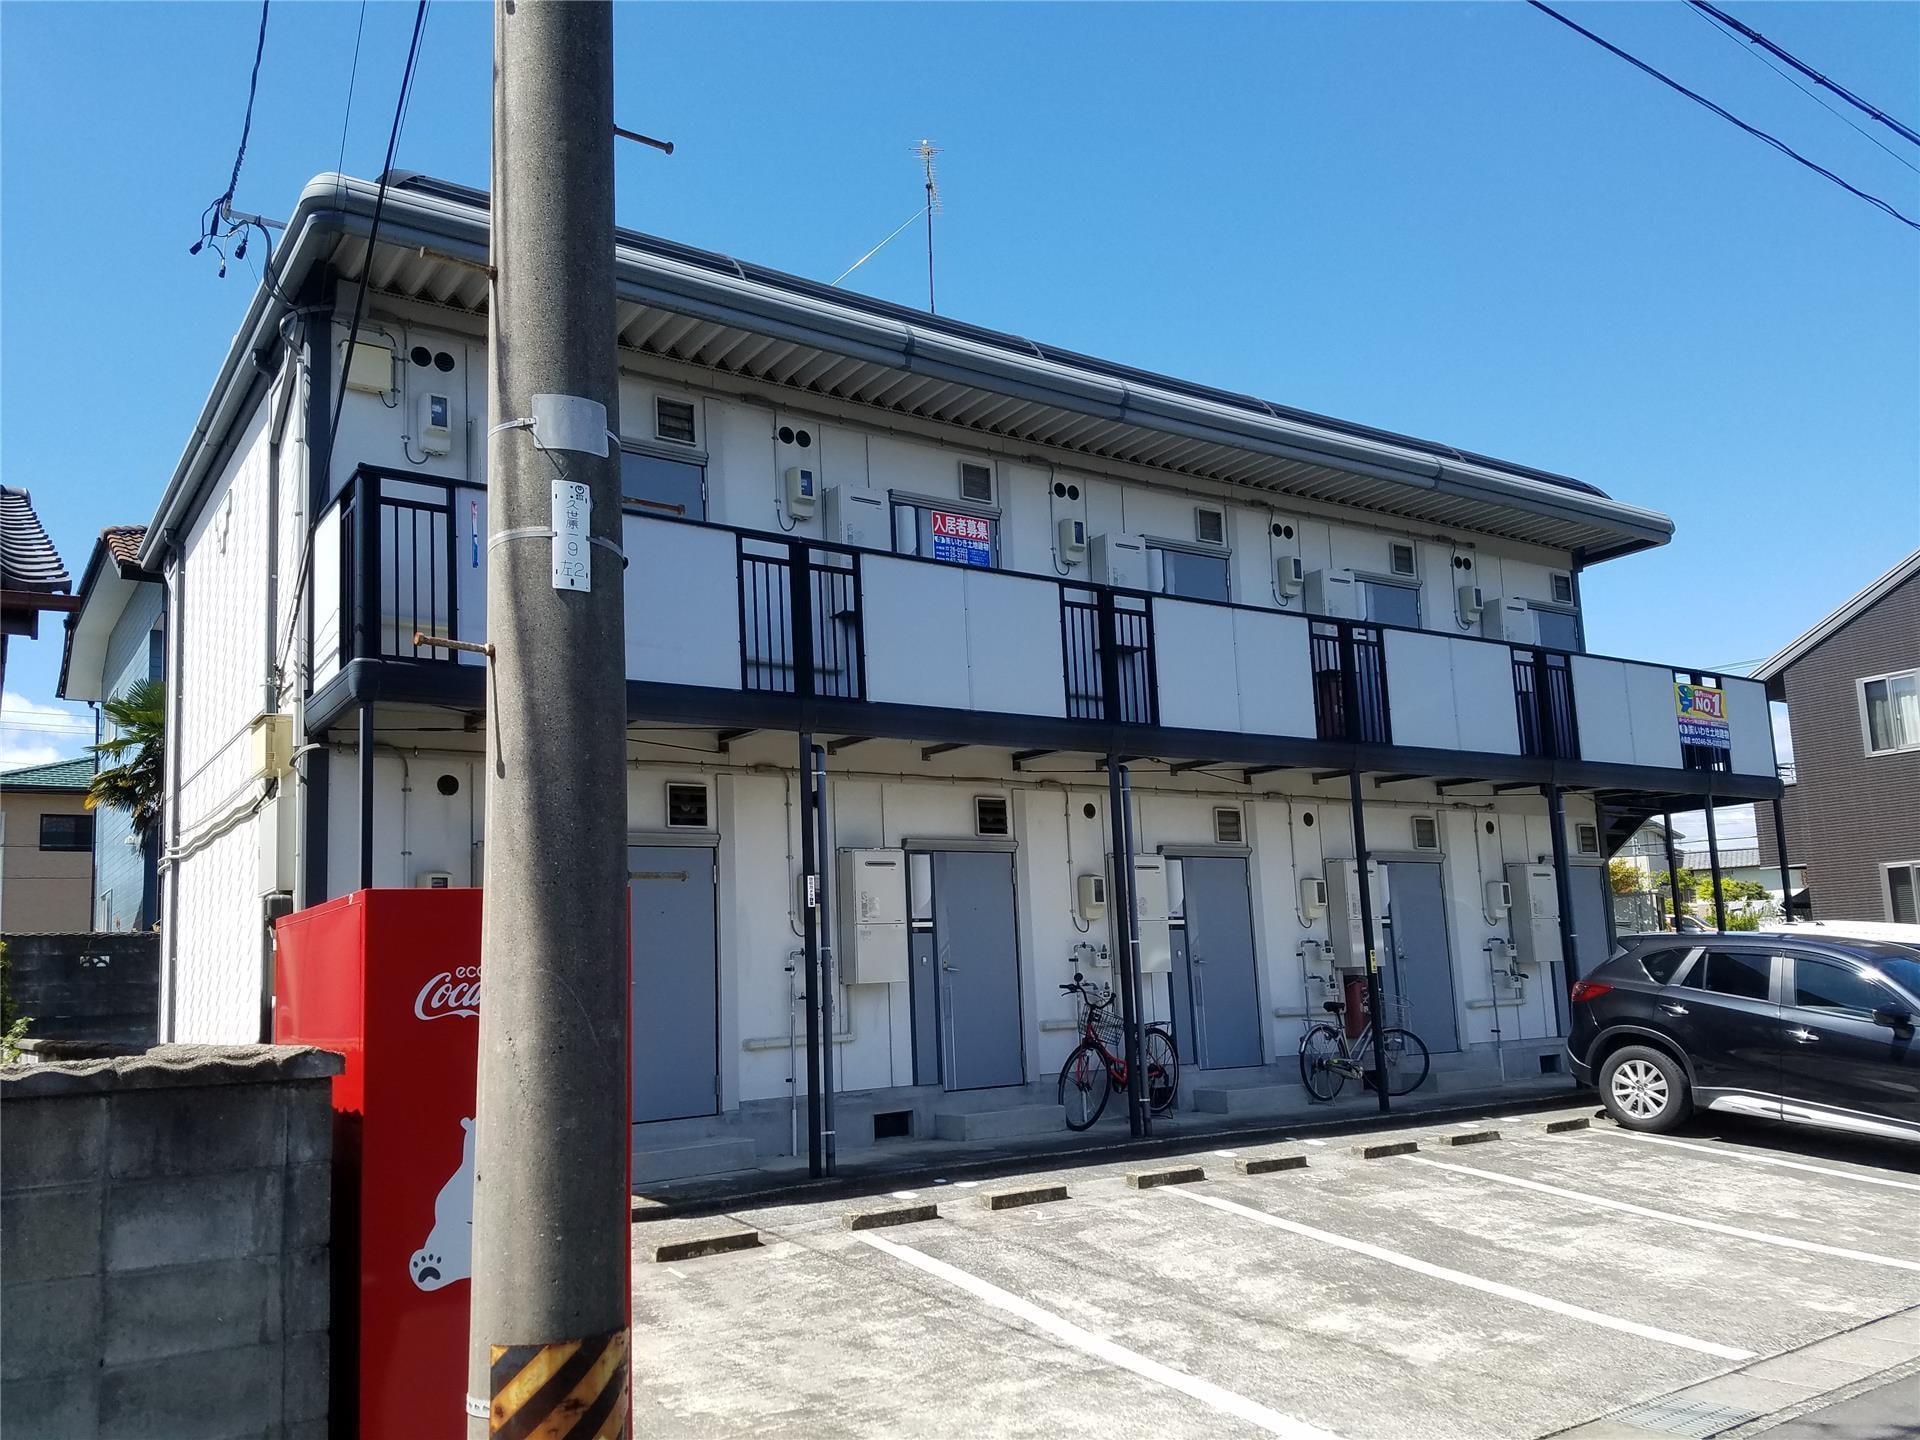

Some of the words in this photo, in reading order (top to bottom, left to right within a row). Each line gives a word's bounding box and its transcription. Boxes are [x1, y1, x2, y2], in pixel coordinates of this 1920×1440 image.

[934, 514, 988, 540] 入居者募集
[1695, 693, 1721, 716] NO.1
